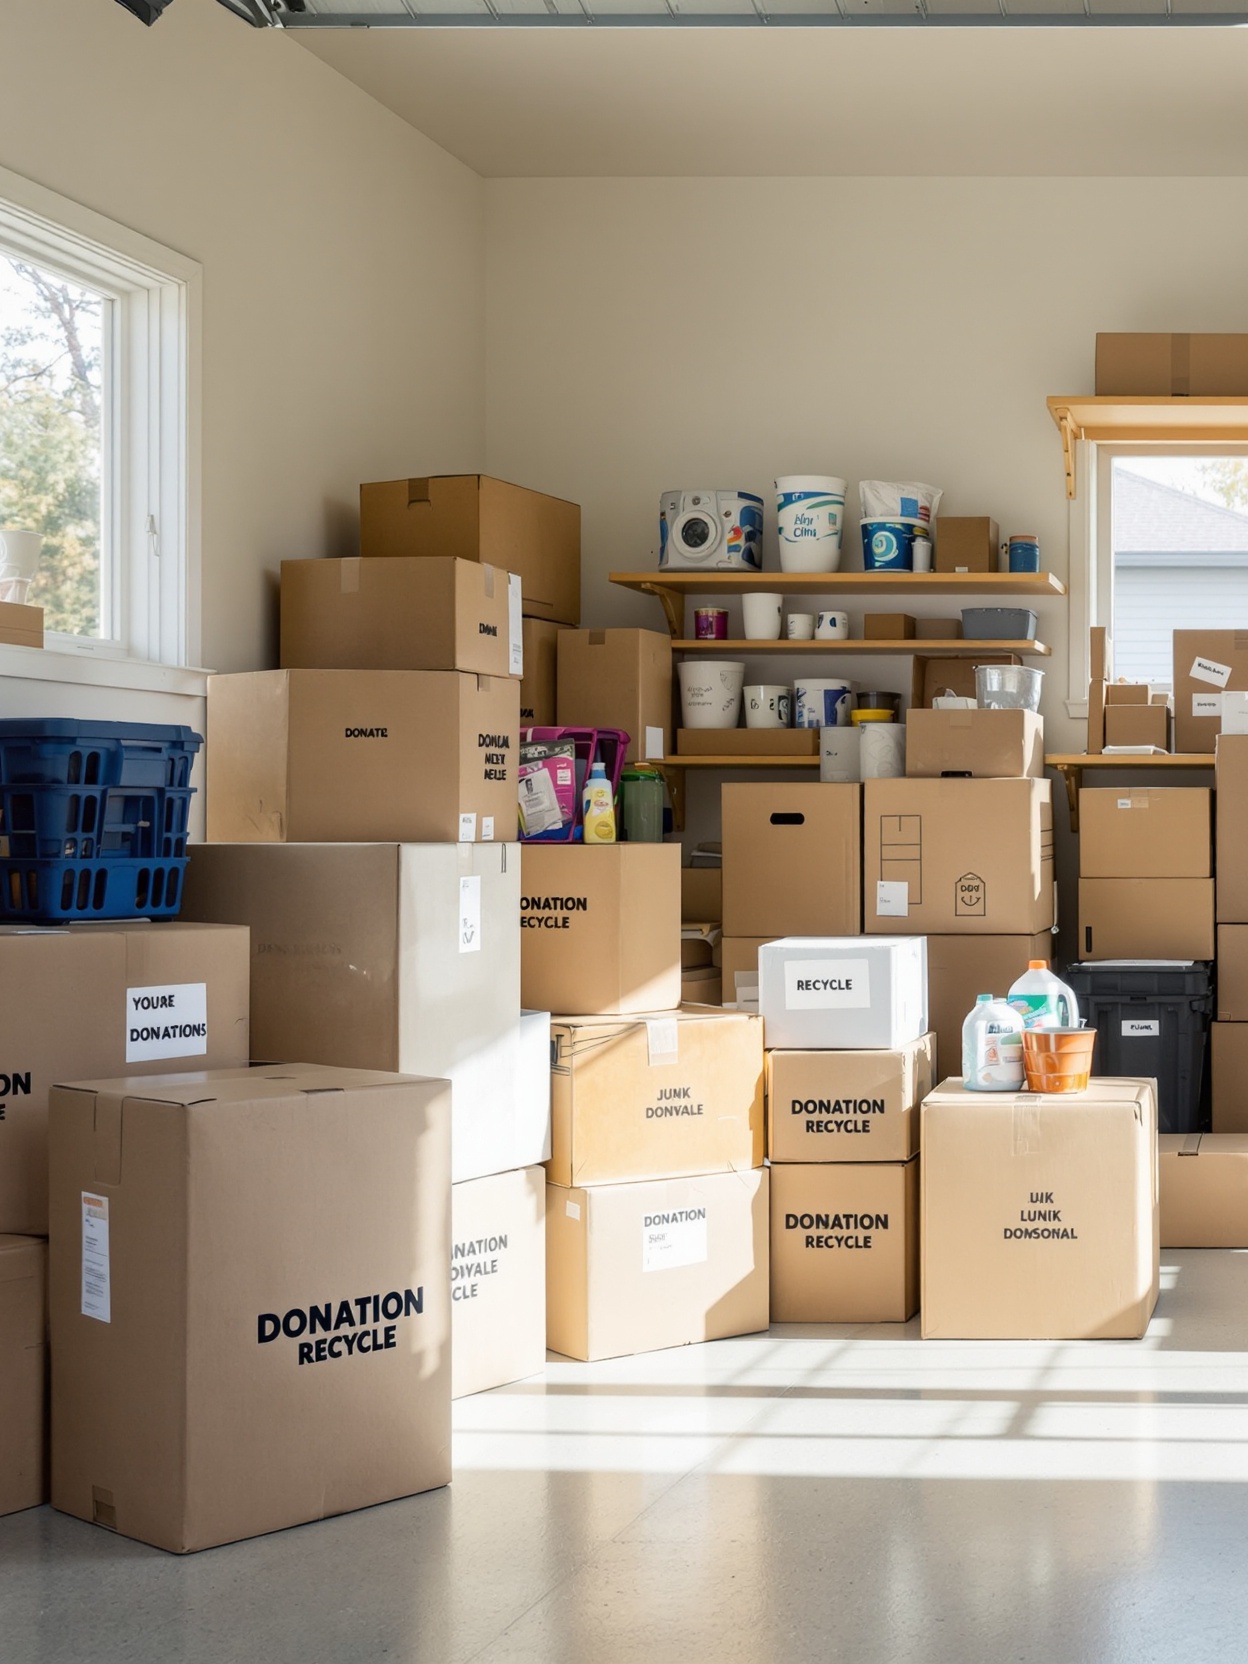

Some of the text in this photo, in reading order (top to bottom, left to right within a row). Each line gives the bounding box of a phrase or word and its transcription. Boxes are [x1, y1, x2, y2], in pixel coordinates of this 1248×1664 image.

[345, 727, 388, 738] DONATE
[519, 897, 588, 911] ONATION
[520, 916, 570, 929] ECYCLE
[796, 979, 853, 991] RECYCLE
[132, 994, 175, 1011] YOURE
[130, 1023, 206, 1042] DONATIONS
[657, 1087, 691, 1101] JUNK
[791, 1099, 885, 1115] DONATION
[805, 1119, 870, 1134] RECYCLE
[644, 1208, 706, 1228] DONATION
[785, 1213, 889, 1230] DONATION
[451, 1233, 508, 1260] NATION
[805, 1235, 872, 1249] RECYCLE
[257, 1286, 424, 1344] DONATION
[298, 1325, 397, 1366] RECYCLE
